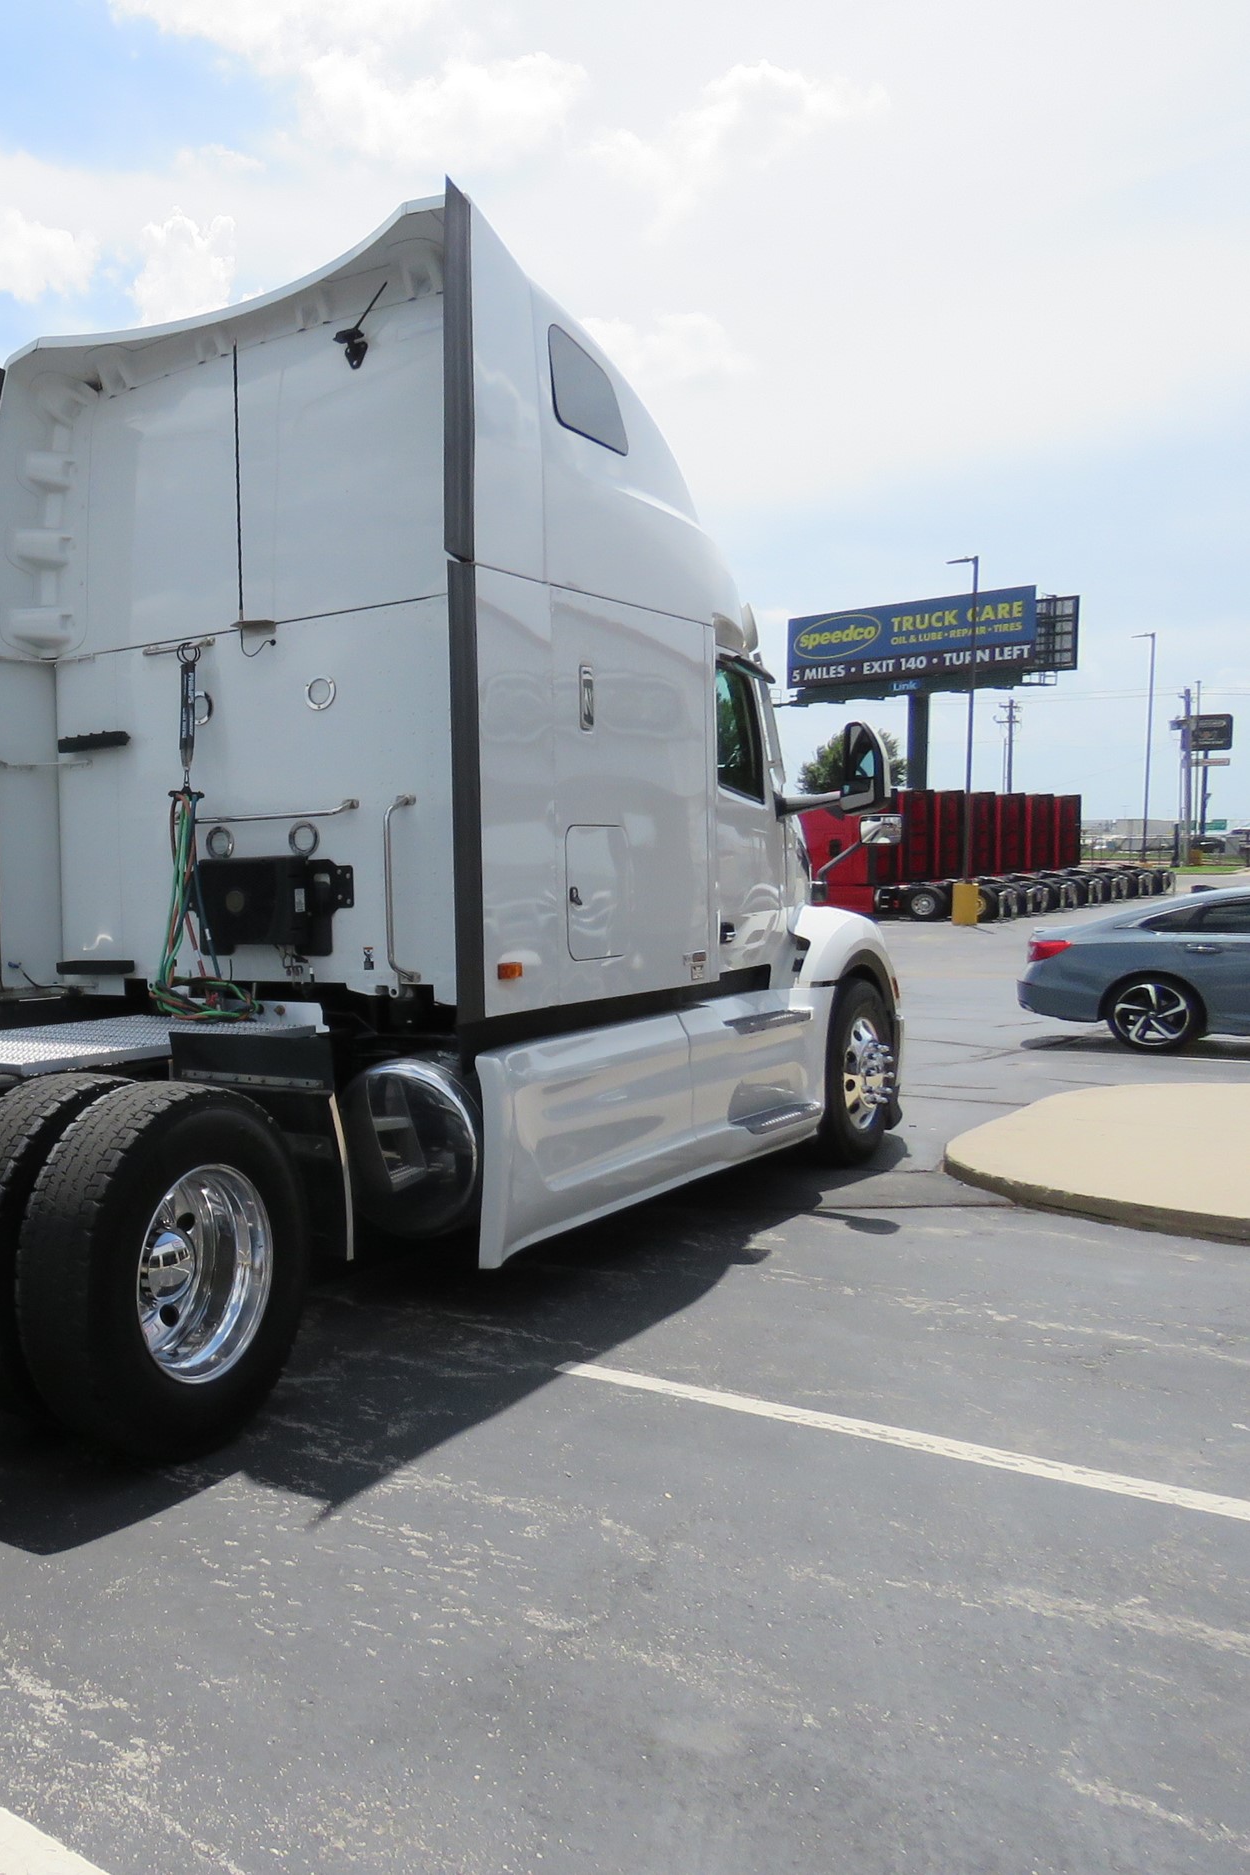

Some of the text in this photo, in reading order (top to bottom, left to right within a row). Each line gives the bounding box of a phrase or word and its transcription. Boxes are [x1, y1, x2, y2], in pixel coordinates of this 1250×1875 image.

[891, 601, 1023, 632] TRUCK CARE
[800, 625, 875, 649] speedco
[891, 636, 907, 646] OIL
[909, 634, 916, 642] &
[918, 631, 942, 642] LUBE
[994, 622, 1022, 632] TIRES
[792, 645, 1031, 682] 5 MILES EXIT 140 TURN LEFT
